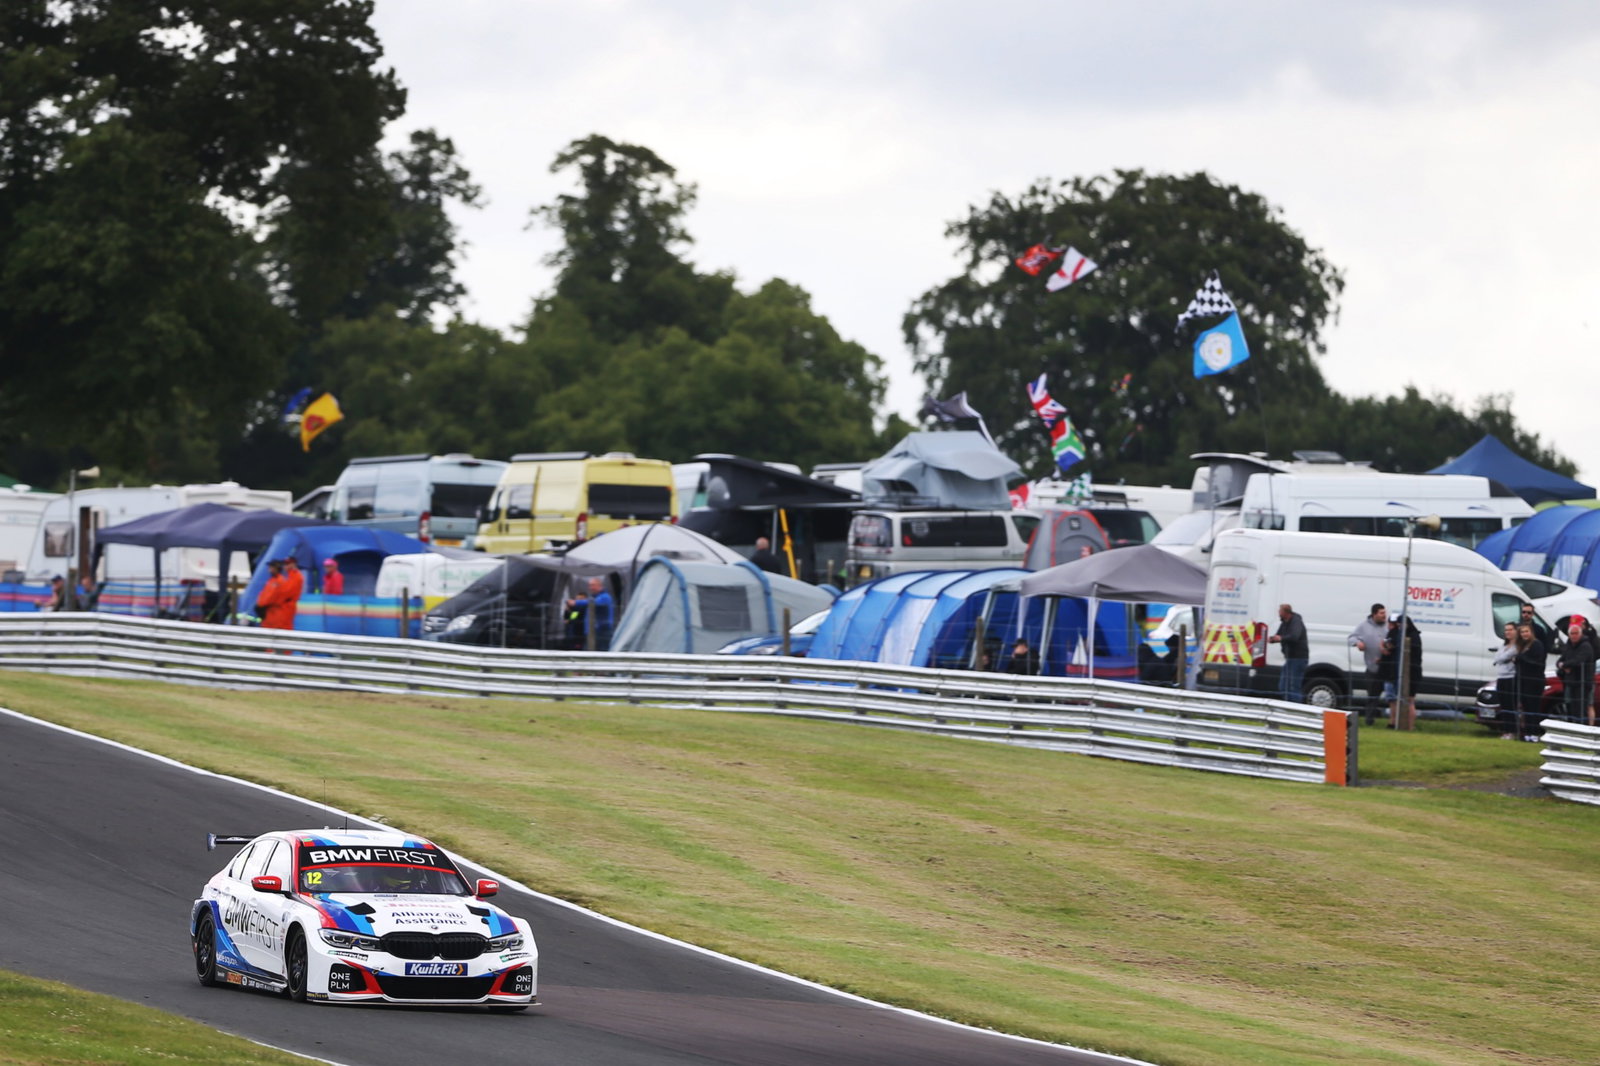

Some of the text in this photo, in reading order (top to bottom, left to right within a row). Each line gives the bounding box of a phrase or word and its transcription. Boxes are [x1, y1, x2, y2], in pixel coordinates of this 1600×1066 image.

[1407, 586, 1442, 601] POWER
[306, 871, 323, 885] 12
[395, 918, 468, 926] Assistance
[330, 972, 350, 981] ONE
[516, 974, 531, 983] ONE
[330, 981, 350, 990] PLM
[515, 984, 531, 992] PLM
